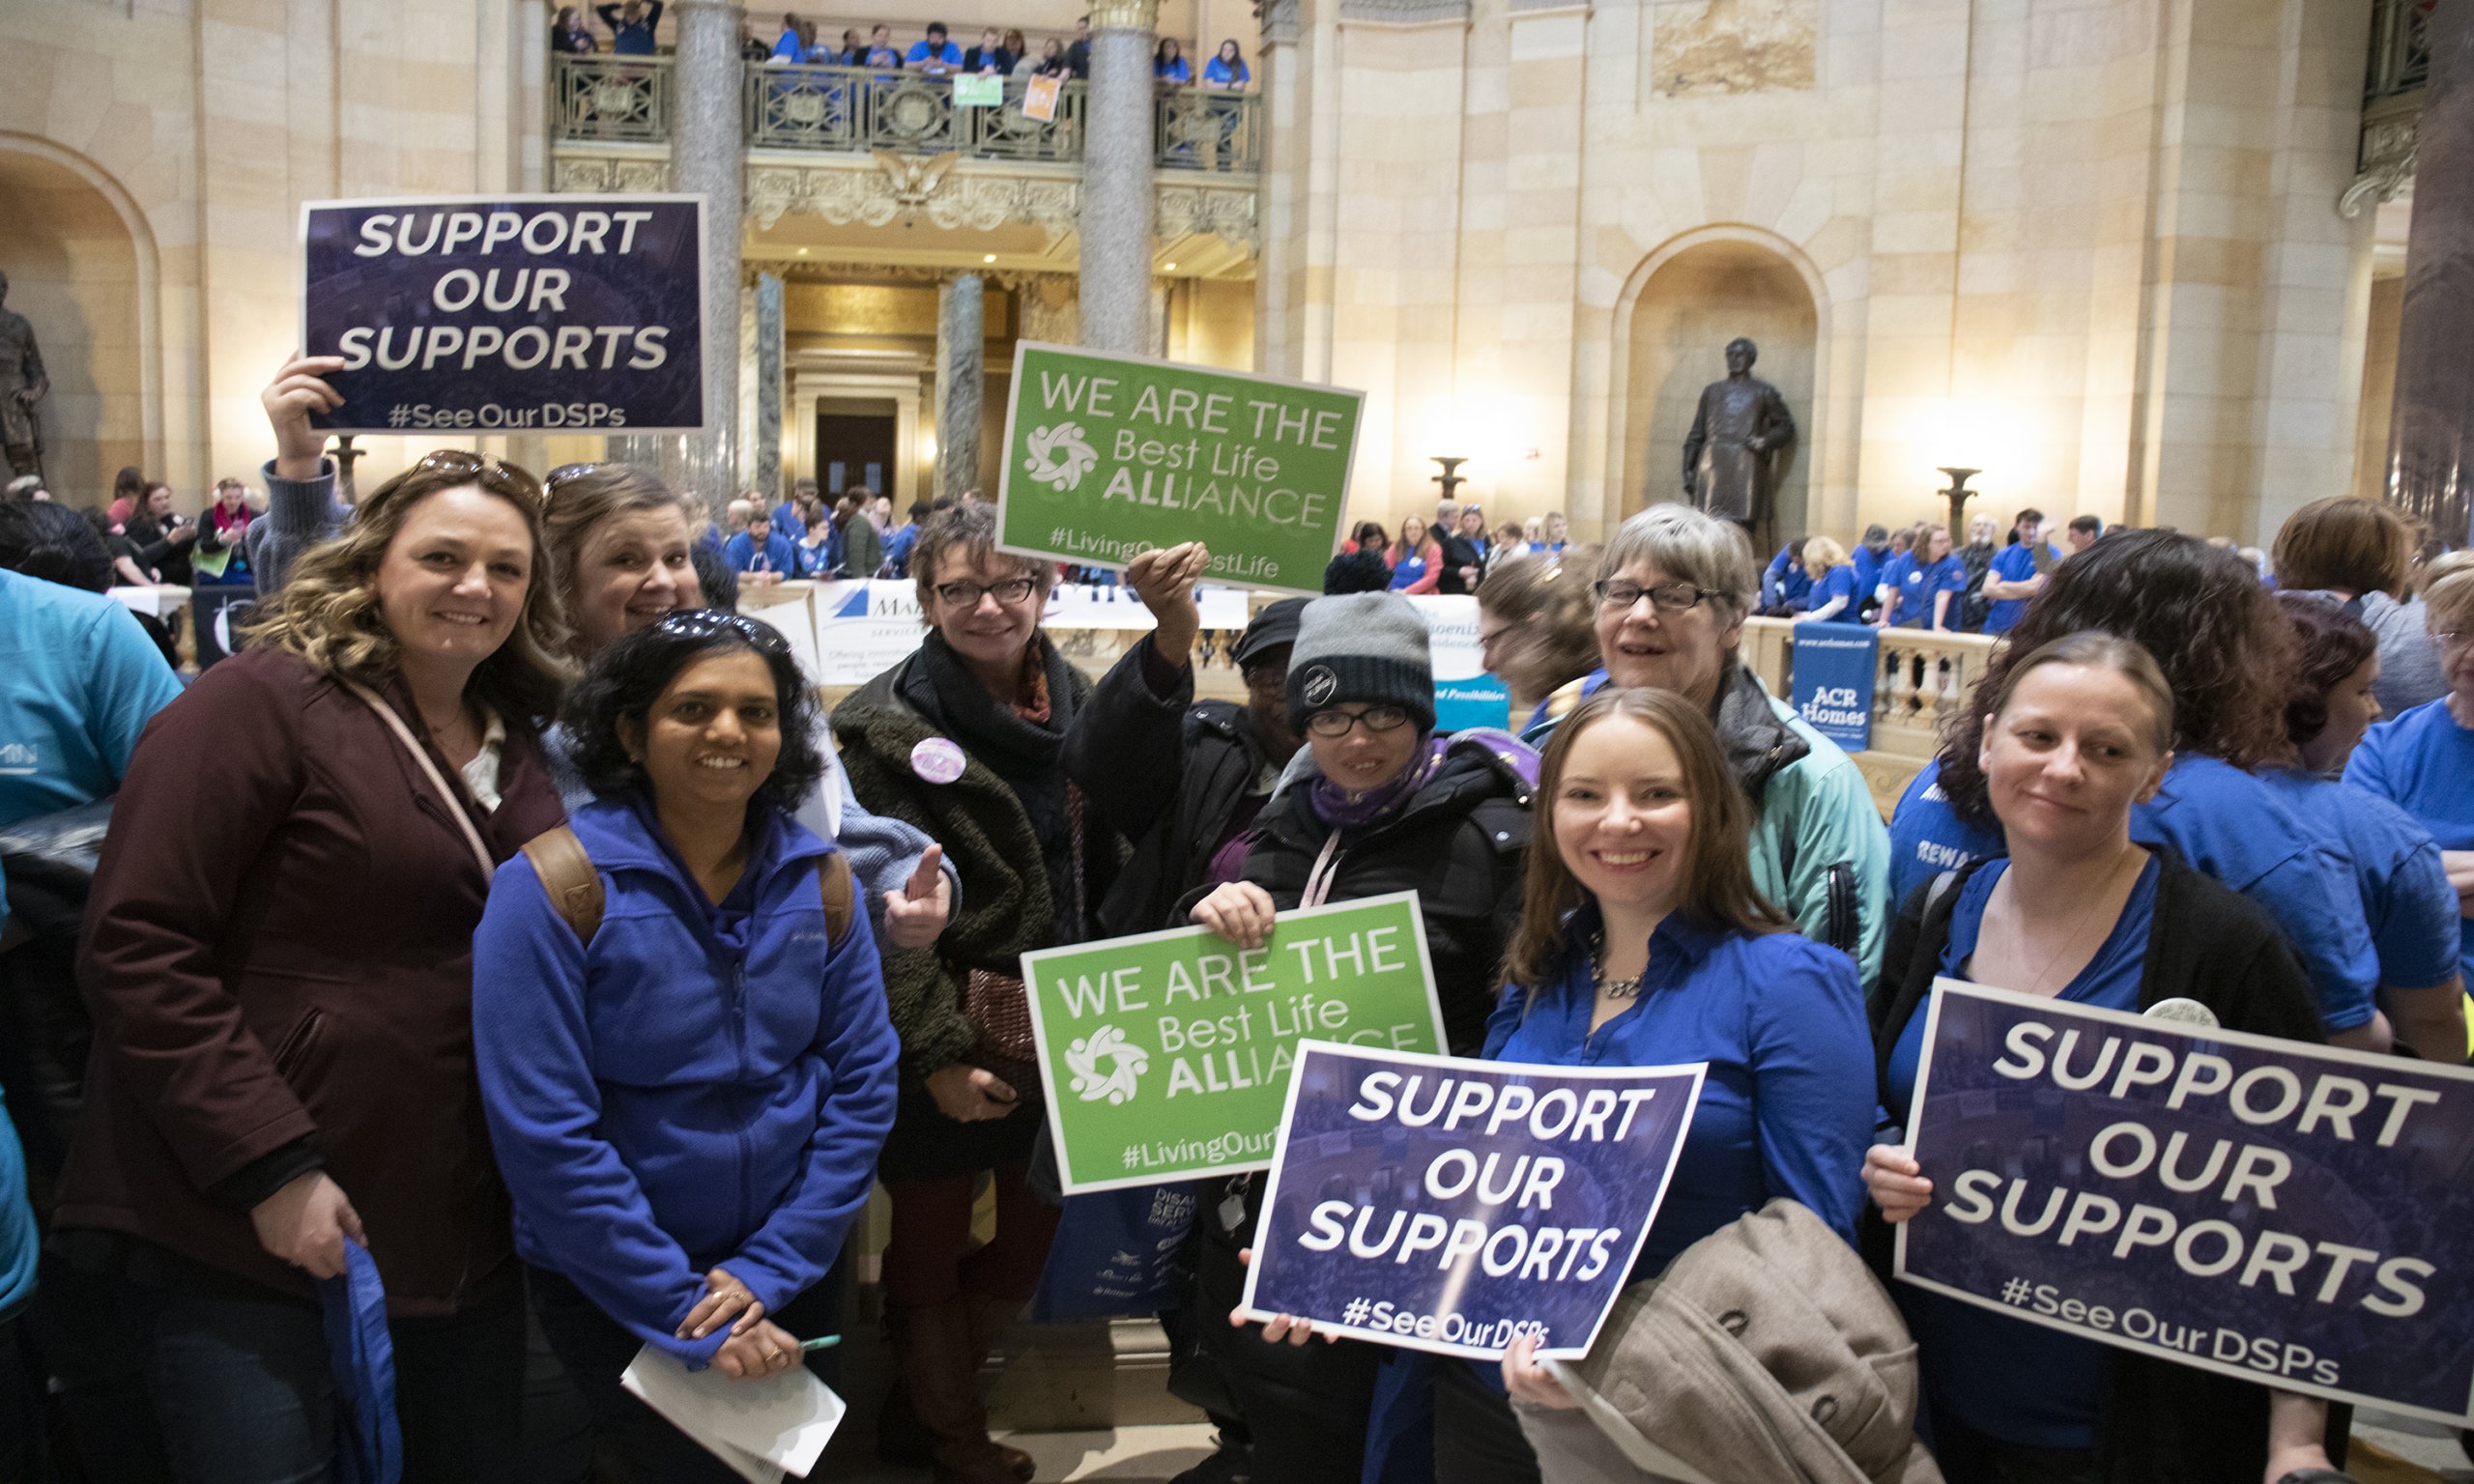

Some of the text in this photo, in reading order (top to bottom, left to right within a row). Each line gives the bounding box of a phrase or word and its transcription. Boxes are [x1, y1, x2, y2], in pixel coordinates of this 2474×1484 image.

[353, 210, 653, 258] SUPPORT
[432, 268, 572, 313] OUR
[337, 325, 671, 372] SUPPORTS
[1041, 370, 1342, 450] WE ARE THE
[1112, 428, 1280, 483] Best Life
[1102, 466, 1327, 528] ALLIANCE
[1801, 702, 1866, 727] Homes
[1814, 686, 1857, 708] ACR
[1916, 840, 1979, 870] REWA
[1057, 926, 1406, 1019] WE ARE THE
[1159, 993, 1349, 1053] Best Life
[1348, 1070, 1656, 1143] SUPPORT
[1992, 1021, 2441, 1148] SUPPORT
[1424, 1148, 1566, 1210] OUR
[2089, 1122, 2292, 1211] OUR
[1297, 1200, 1622, 1283] SUPPORTS
[1943, 1169, 2436, 1317] SUPPORTS
